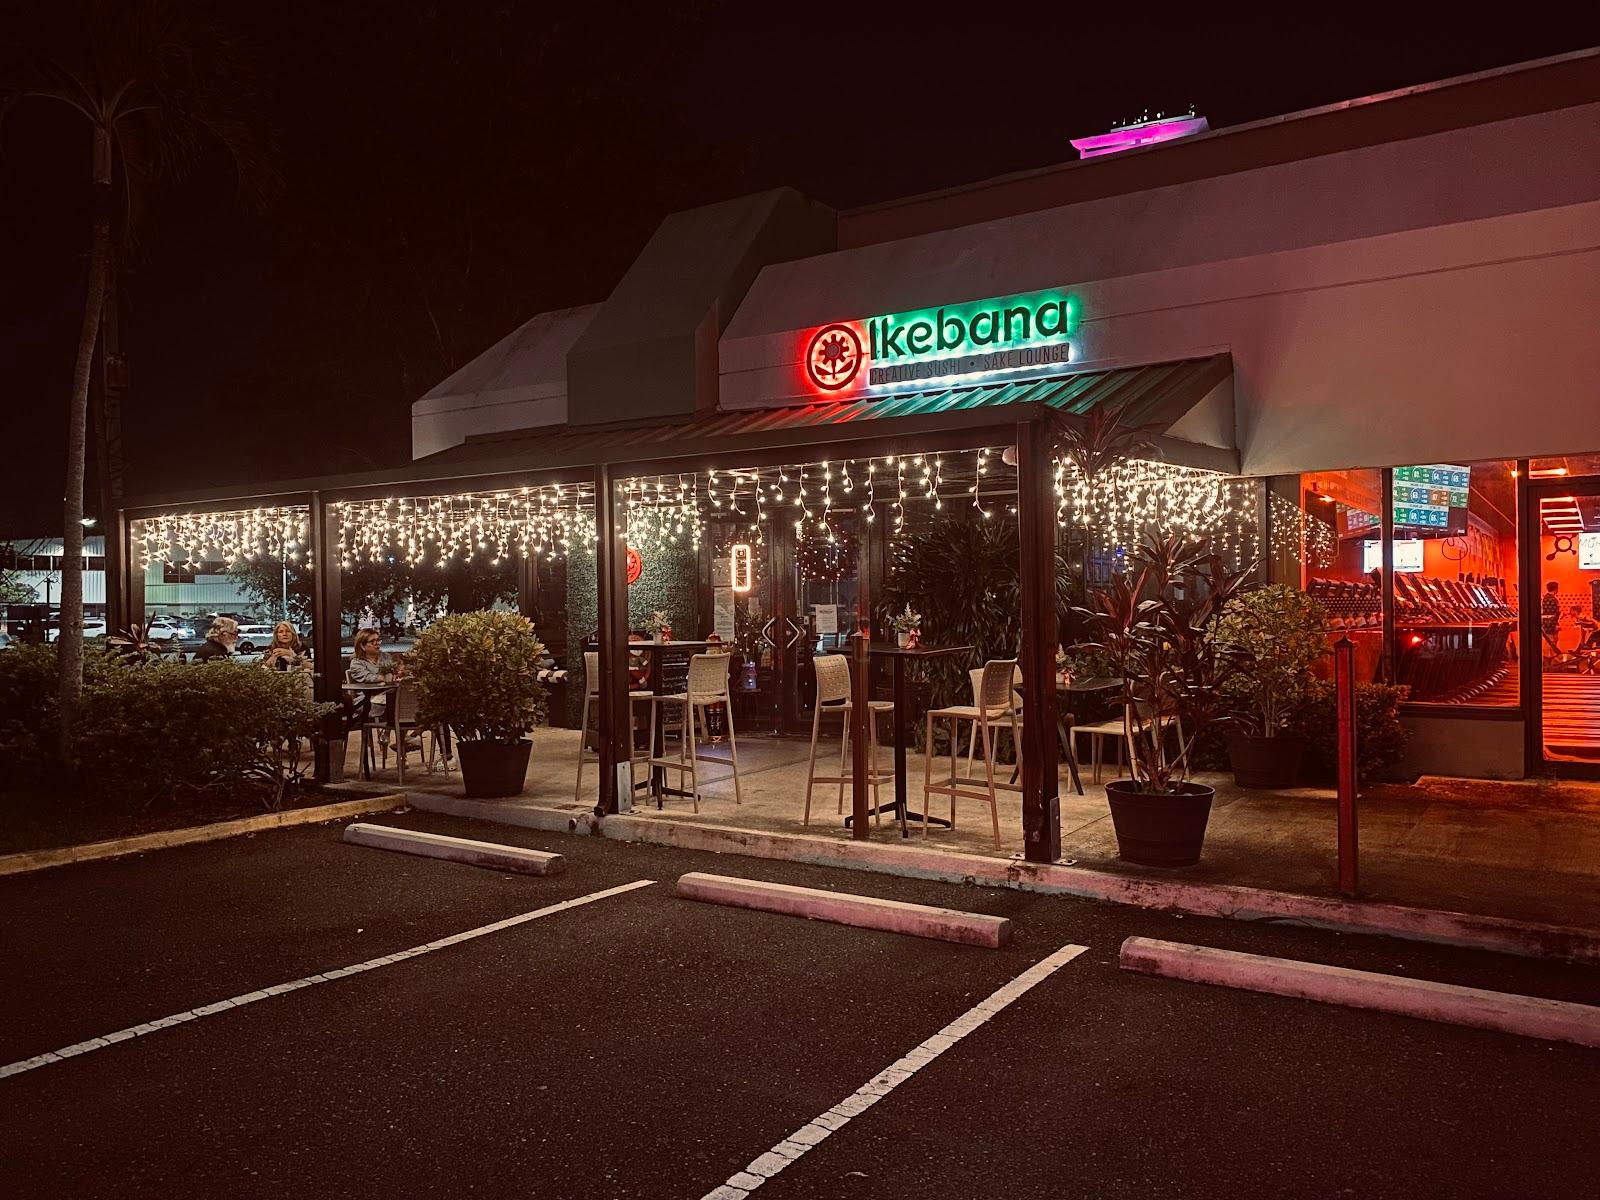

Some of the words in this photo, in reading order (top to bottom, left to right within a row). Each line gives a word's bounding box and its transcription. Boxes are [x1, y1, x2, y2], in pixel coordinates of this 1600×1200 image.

[869, 301, 1067, 360] Ikebana
[870, 364, 920, 384] CREATIVE
[927, 359, 960, 378] SUSHI
[984, 351, 1013, 370] SAKE
[1019, 344, 1067, 365] LOUNGE
[736, 548, 747, 588] OPEN
